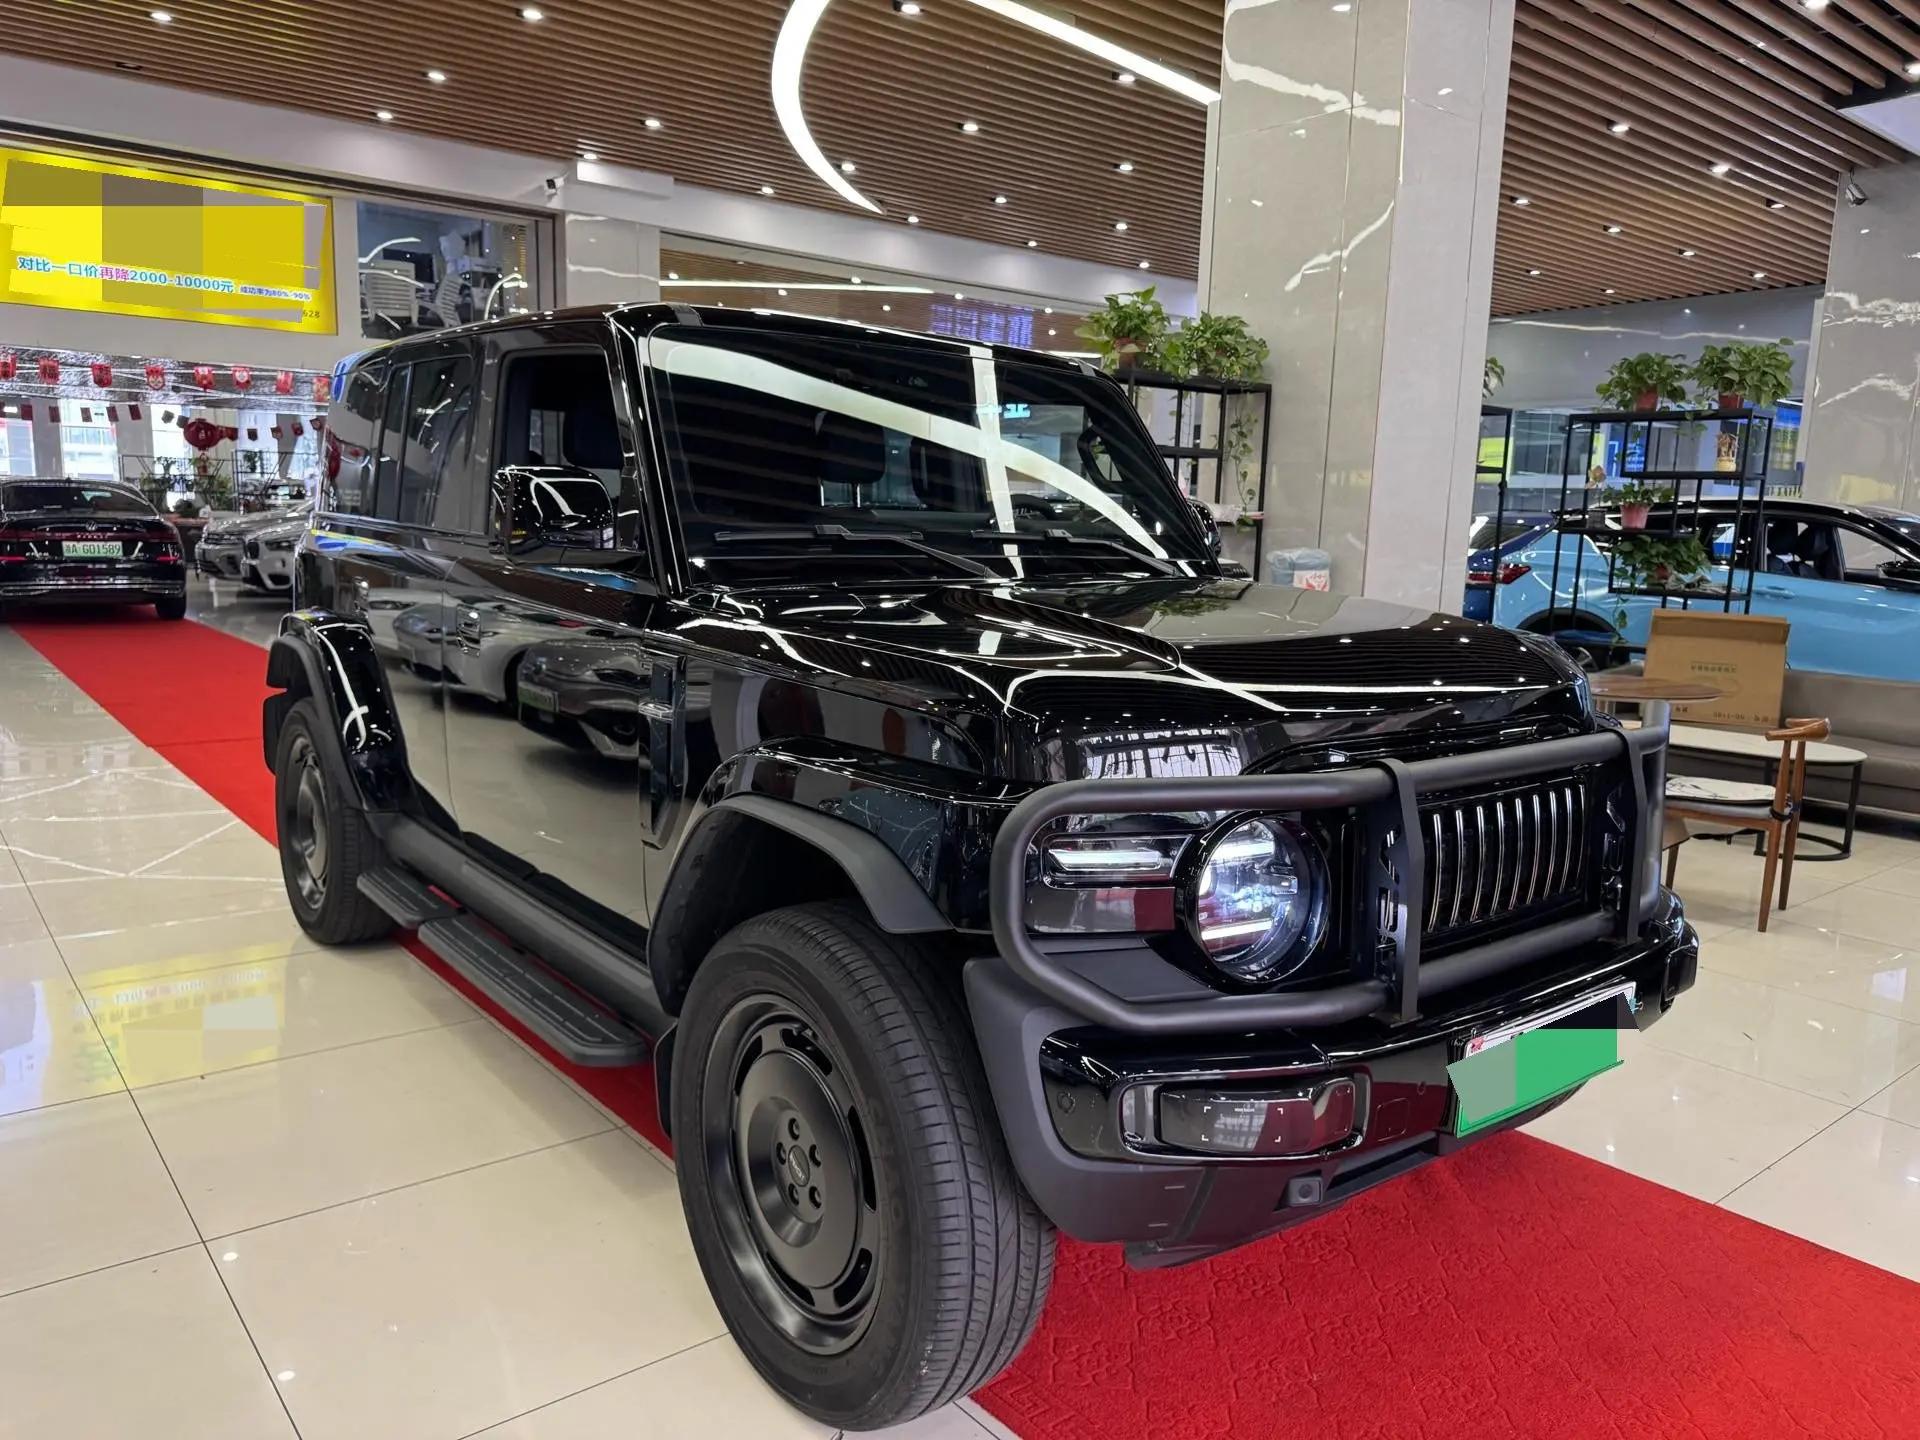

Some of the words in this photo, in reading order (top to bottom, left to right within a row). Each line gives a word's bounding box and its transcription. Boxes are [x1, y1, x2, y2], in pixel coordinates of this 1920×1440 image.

[18, 256, 234, 293] 对比一口价再降2000-10000元
